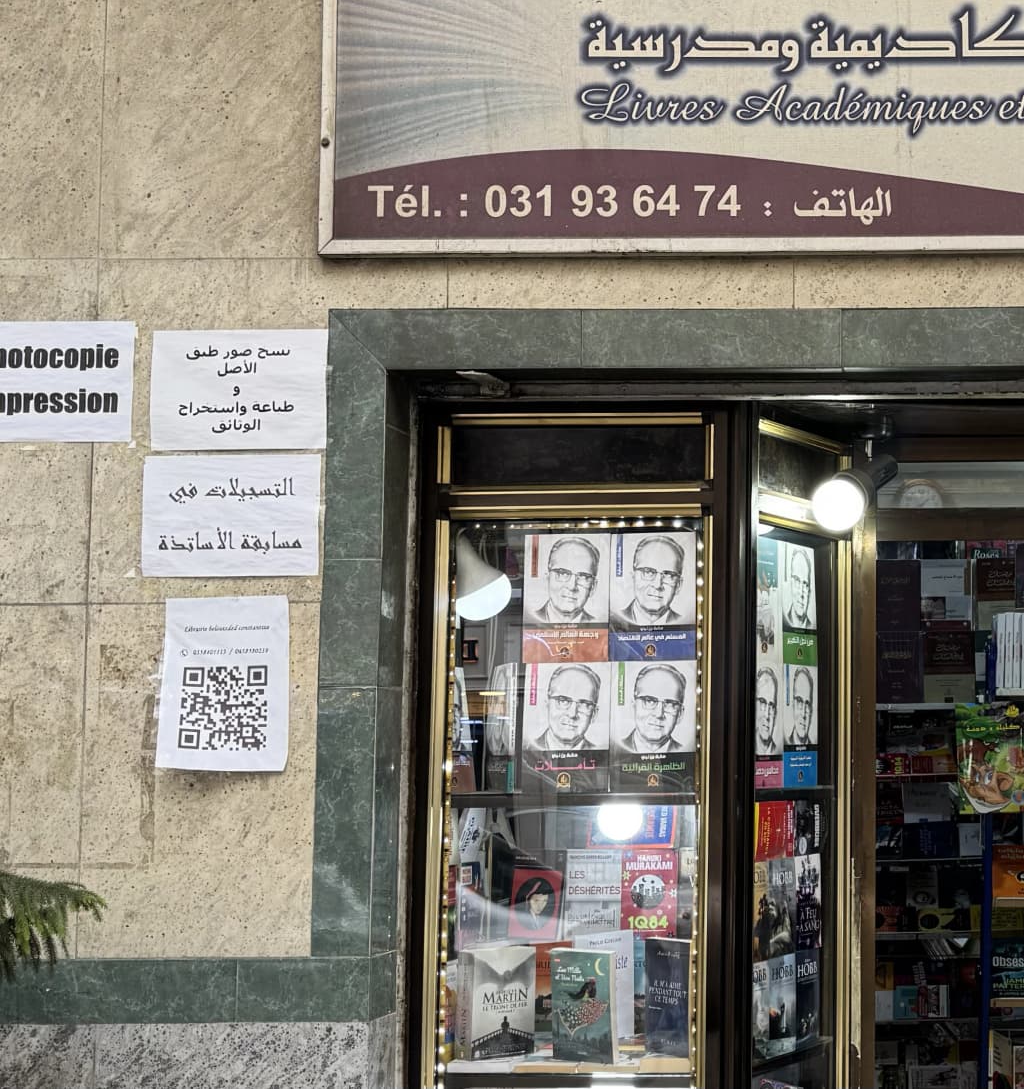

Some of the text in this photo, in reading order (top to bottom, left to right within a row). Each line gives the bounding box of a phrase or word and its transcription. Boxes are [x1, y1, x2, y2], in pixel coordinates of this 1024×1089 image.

[586, 18, 801, 73] ومدرسية
[580, 82, 724, 122] Livres
[735, 83, 997, 136] Académiques
[367, 185, 442, 219] Tél.
[484, 184, 554, 218] 031
[571, 184, 620, 218] 93
[632, 184, 681, 218] 64
[695, 184, 742, 218] 74
[793, 186, 892, 226] الهاتف
[223, 347, 252, 359] صور
[217, 361, 257, 377] الأصل
[233, 384, 241, 396] و
[168, 477, 296, 504] التسجيلات في
[158, 527, 303, 555] مسابقة الأساتذة
[626, 861, 673, 871] MURAKAMI
[637, 854, 662, 862] HARUKI
[569, 870, 585, 880] LES
[772, 870, 793, 886] HOBB
[628, 915, 669, 929] 1Q84
[615, 955, 628, 970] iste
[797, 961, 819, 978] HOBB
[771, 964, 794, 981] HOBB
[482, 987, 529, 1005] MARTIN
